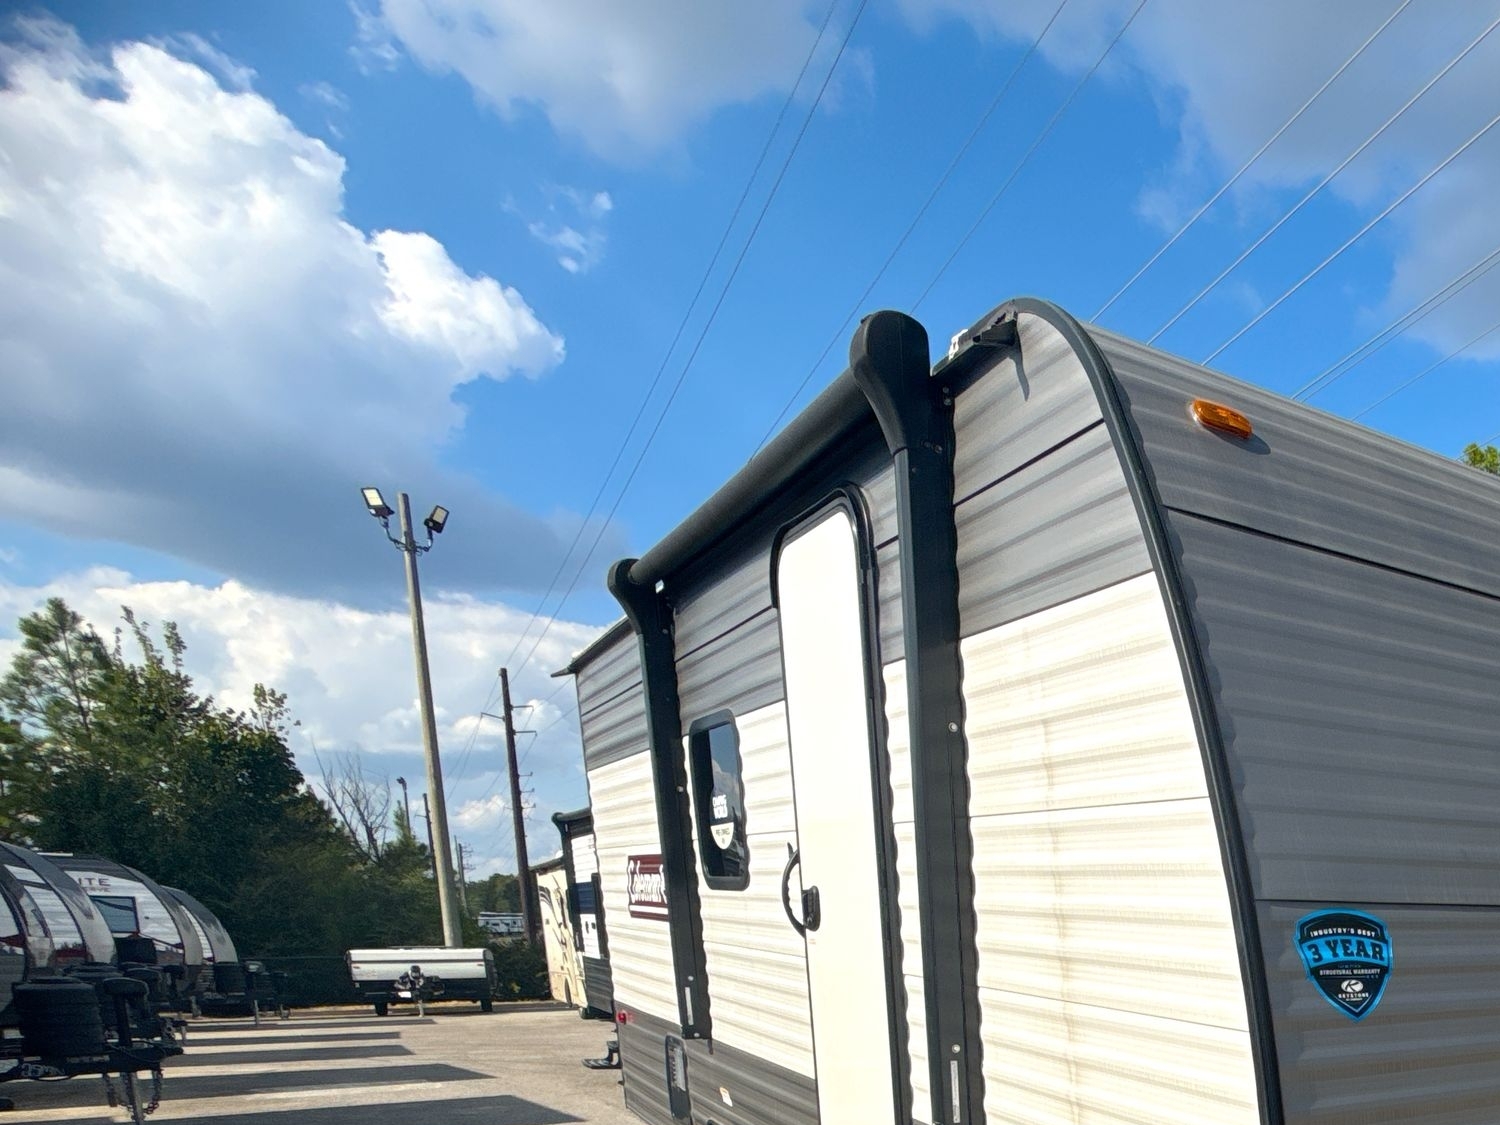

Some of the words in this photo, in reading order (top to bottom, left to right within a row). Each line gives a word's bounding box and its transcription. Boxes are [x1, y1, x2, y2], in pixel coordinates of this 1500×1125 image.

[1357, 928, 1376, 938] BEST
[1307, 943, 1323, 963] 3
[1325, 939, 1385, 961] YEAR
